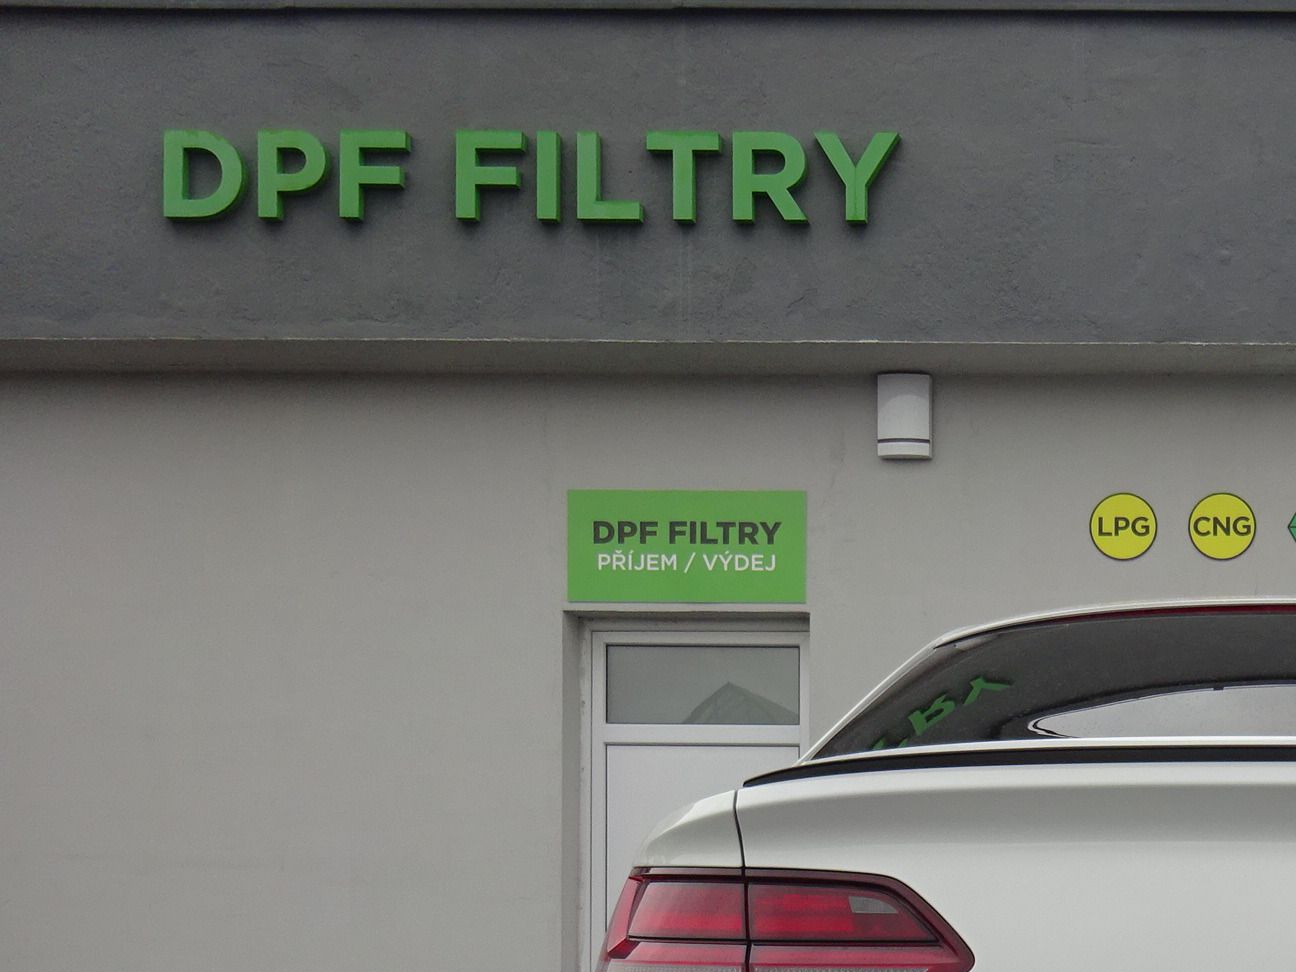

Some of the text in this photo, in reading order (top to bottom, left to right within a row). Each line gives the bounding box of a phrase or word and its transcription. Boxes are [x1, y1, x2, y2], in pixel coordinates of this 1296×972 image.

[163, 130, 902, 224] DPF FILTRY
[592, 520, 782, 545] DPF FILTRY
[1098, 516, 1150, 537] LPG
[1193, 516, 1252, 537] CNG
[598, 549, 678, 571] PŘÍJEM
[702, 550, 777, 572] VÝDEJ
